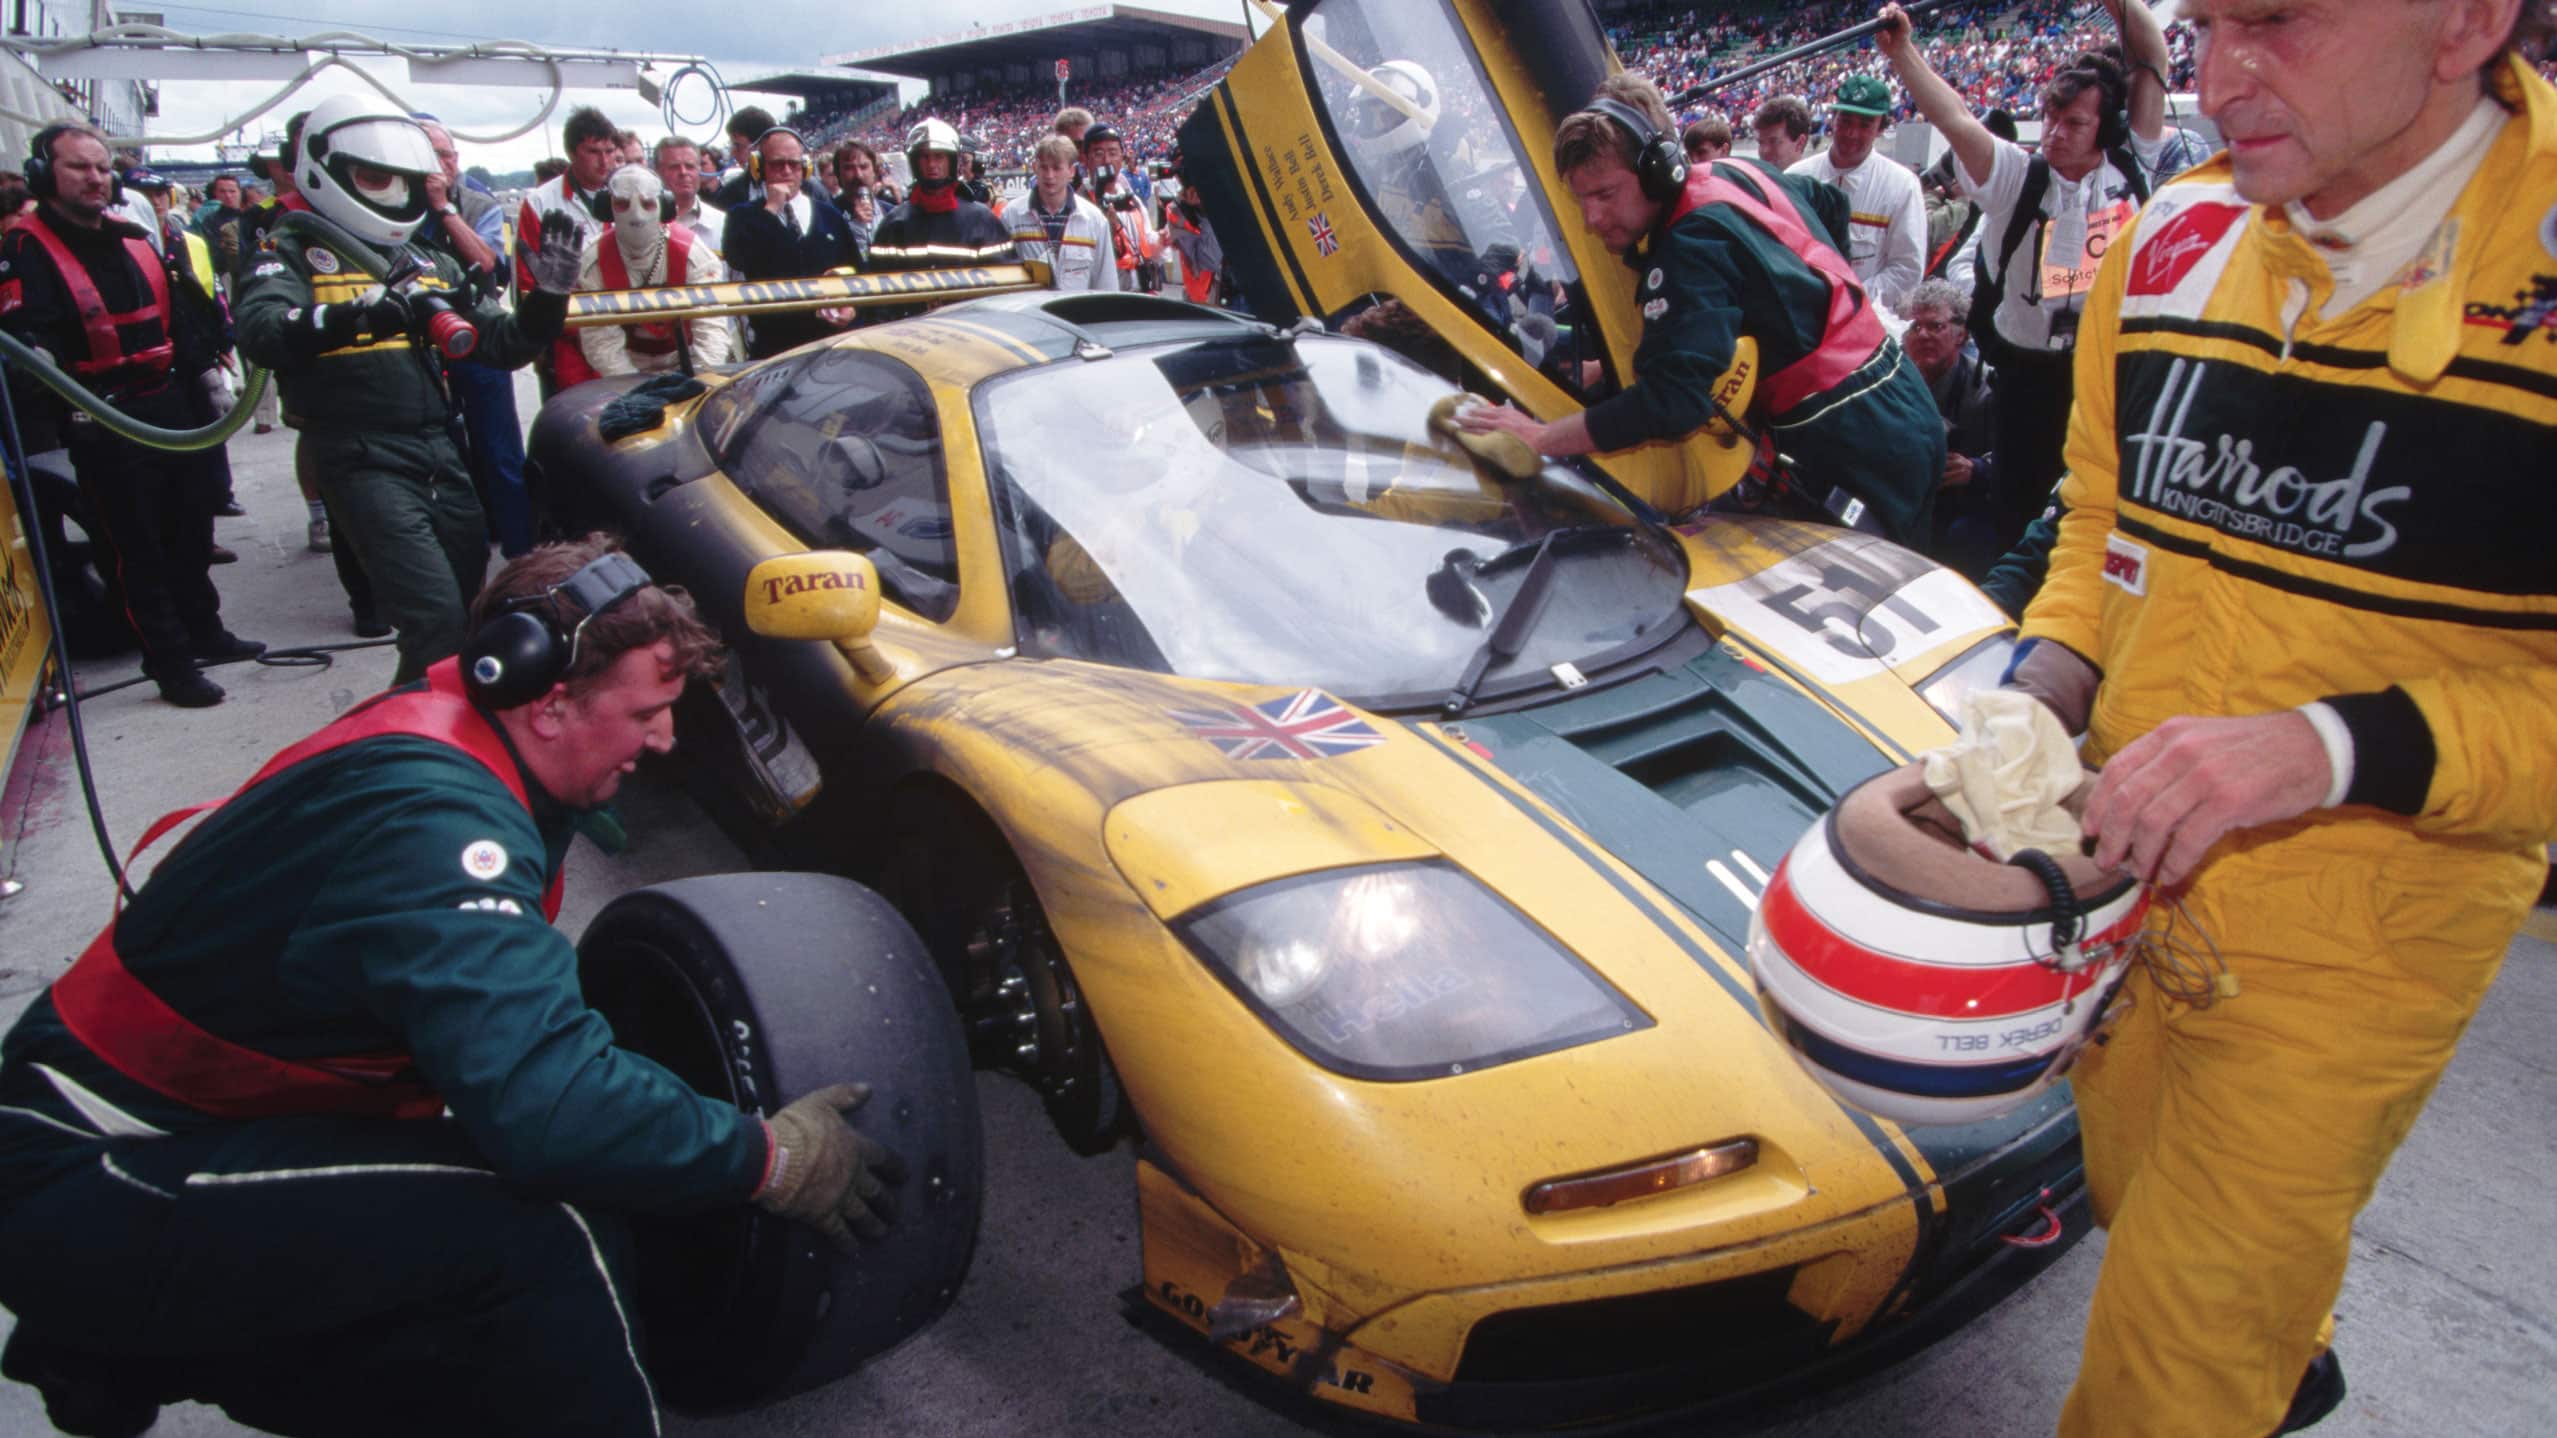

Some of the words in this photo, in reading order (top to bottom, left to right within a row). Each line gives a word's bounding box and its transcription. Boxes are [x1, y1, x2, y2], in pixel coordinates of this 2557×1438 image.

[1284, 150, 1300, 175] Bell
[1298, 134, 1317, 160] Bell
[1264, 145, 1284, 192] Wallace
[1312, 162, 1334, 202] Derek
[1298, 176, 1316, 211] Justin
[2146, 215, 2209, 286] Virgin
[575, 286, 719, 314] MACH
[738, 279, 824, 303] ONE
[842, 268, 998, 295] RACING
[2126, 357, 2411, 556] Harrods
[762, 571, 866, 605] Taran
[1757, 563, 1942, 659] 51
[1312, 968, 1472, 1043] Hella
[1936, 1034, 1989, 1051] BELL
[1998, 1017, 2064, 1049] DEREK
